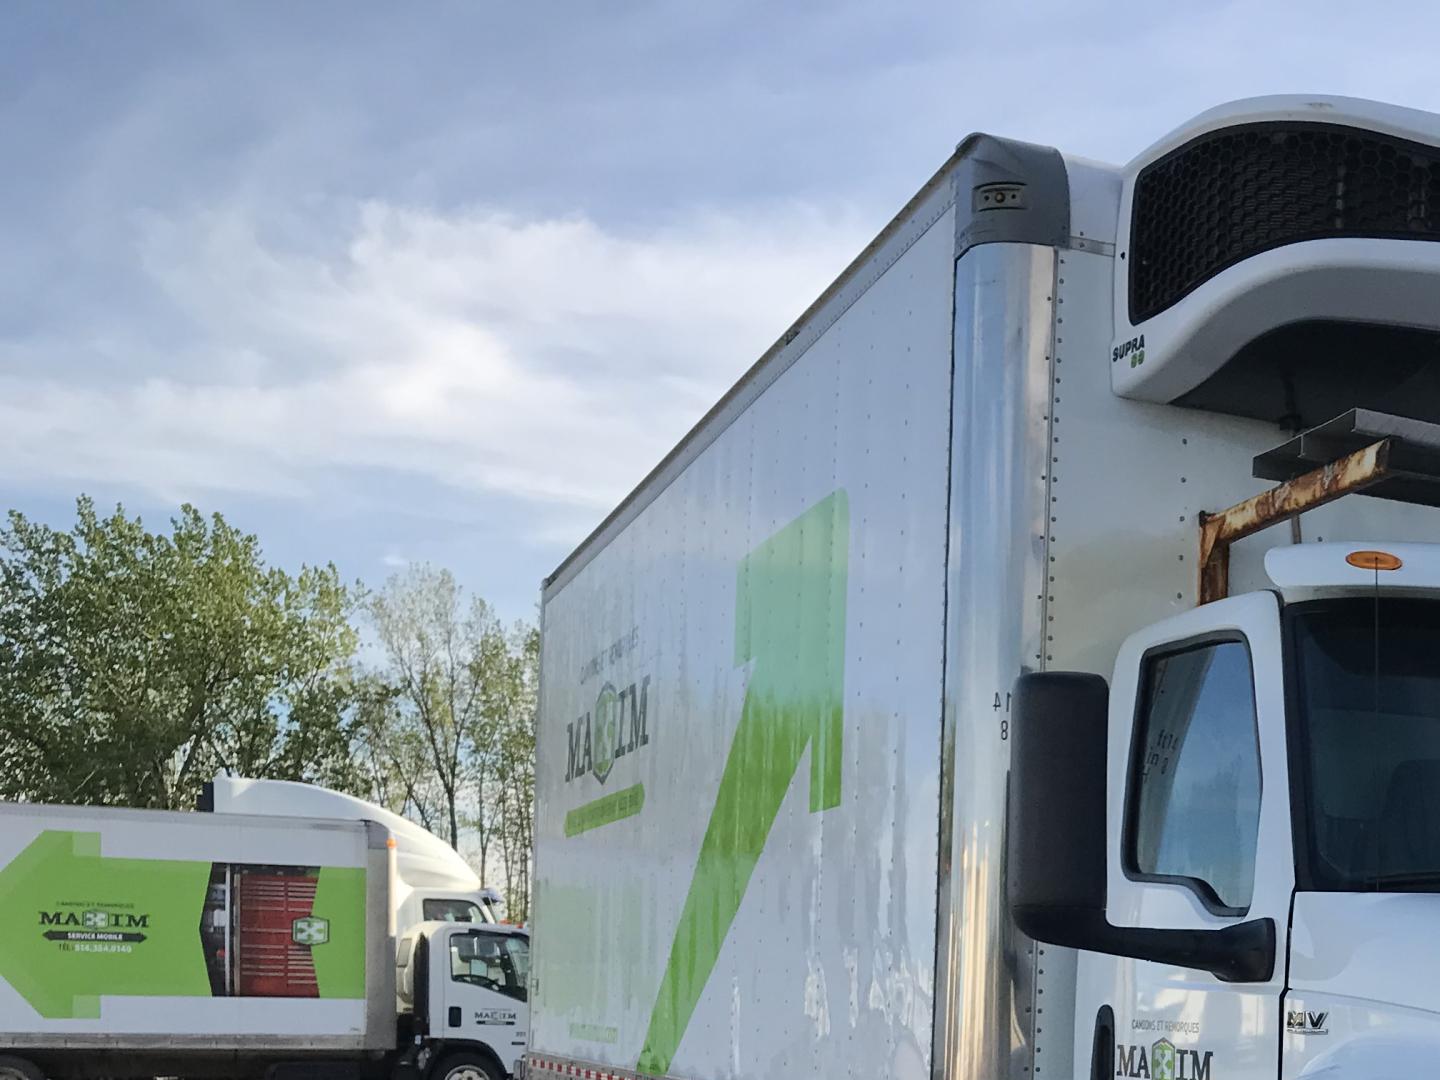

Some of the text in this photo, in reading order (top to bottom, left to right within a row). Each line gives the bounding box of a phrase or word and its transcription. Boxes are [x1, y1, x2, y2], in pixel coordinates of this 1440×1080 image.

[1112, 334, 1145, 362] SUPRA
[39, 910, 150, 929] MAXIM
[67, 932, 123, 941] SERVICE MOBILE
